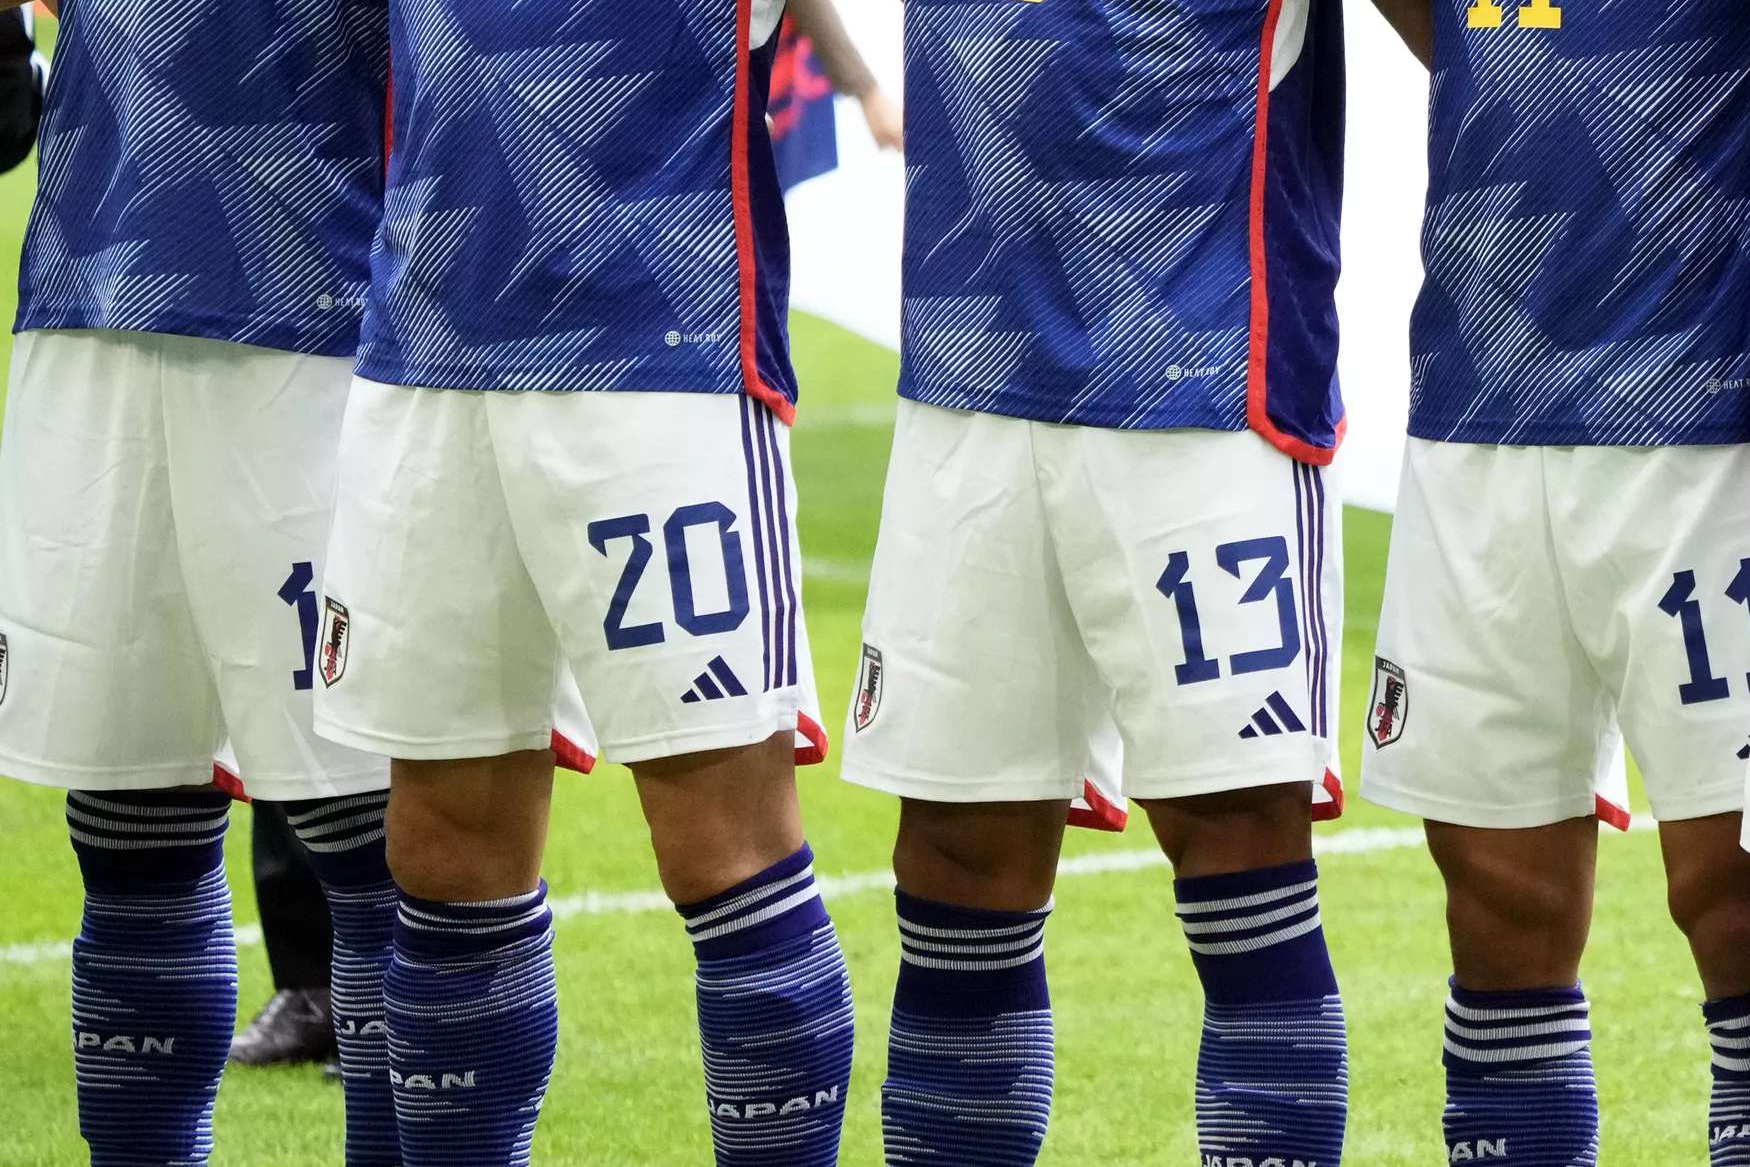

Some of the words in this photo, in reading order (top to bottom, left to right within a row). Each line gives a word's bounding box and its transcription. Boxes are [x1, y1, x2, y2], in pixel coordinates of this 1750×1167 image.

[278, 562, 319, 691] 1
[590, 502, 749, 649] 20
[1159, 536, 1300, 683] 13
[1446, 1138, 1506, 1162] AN
